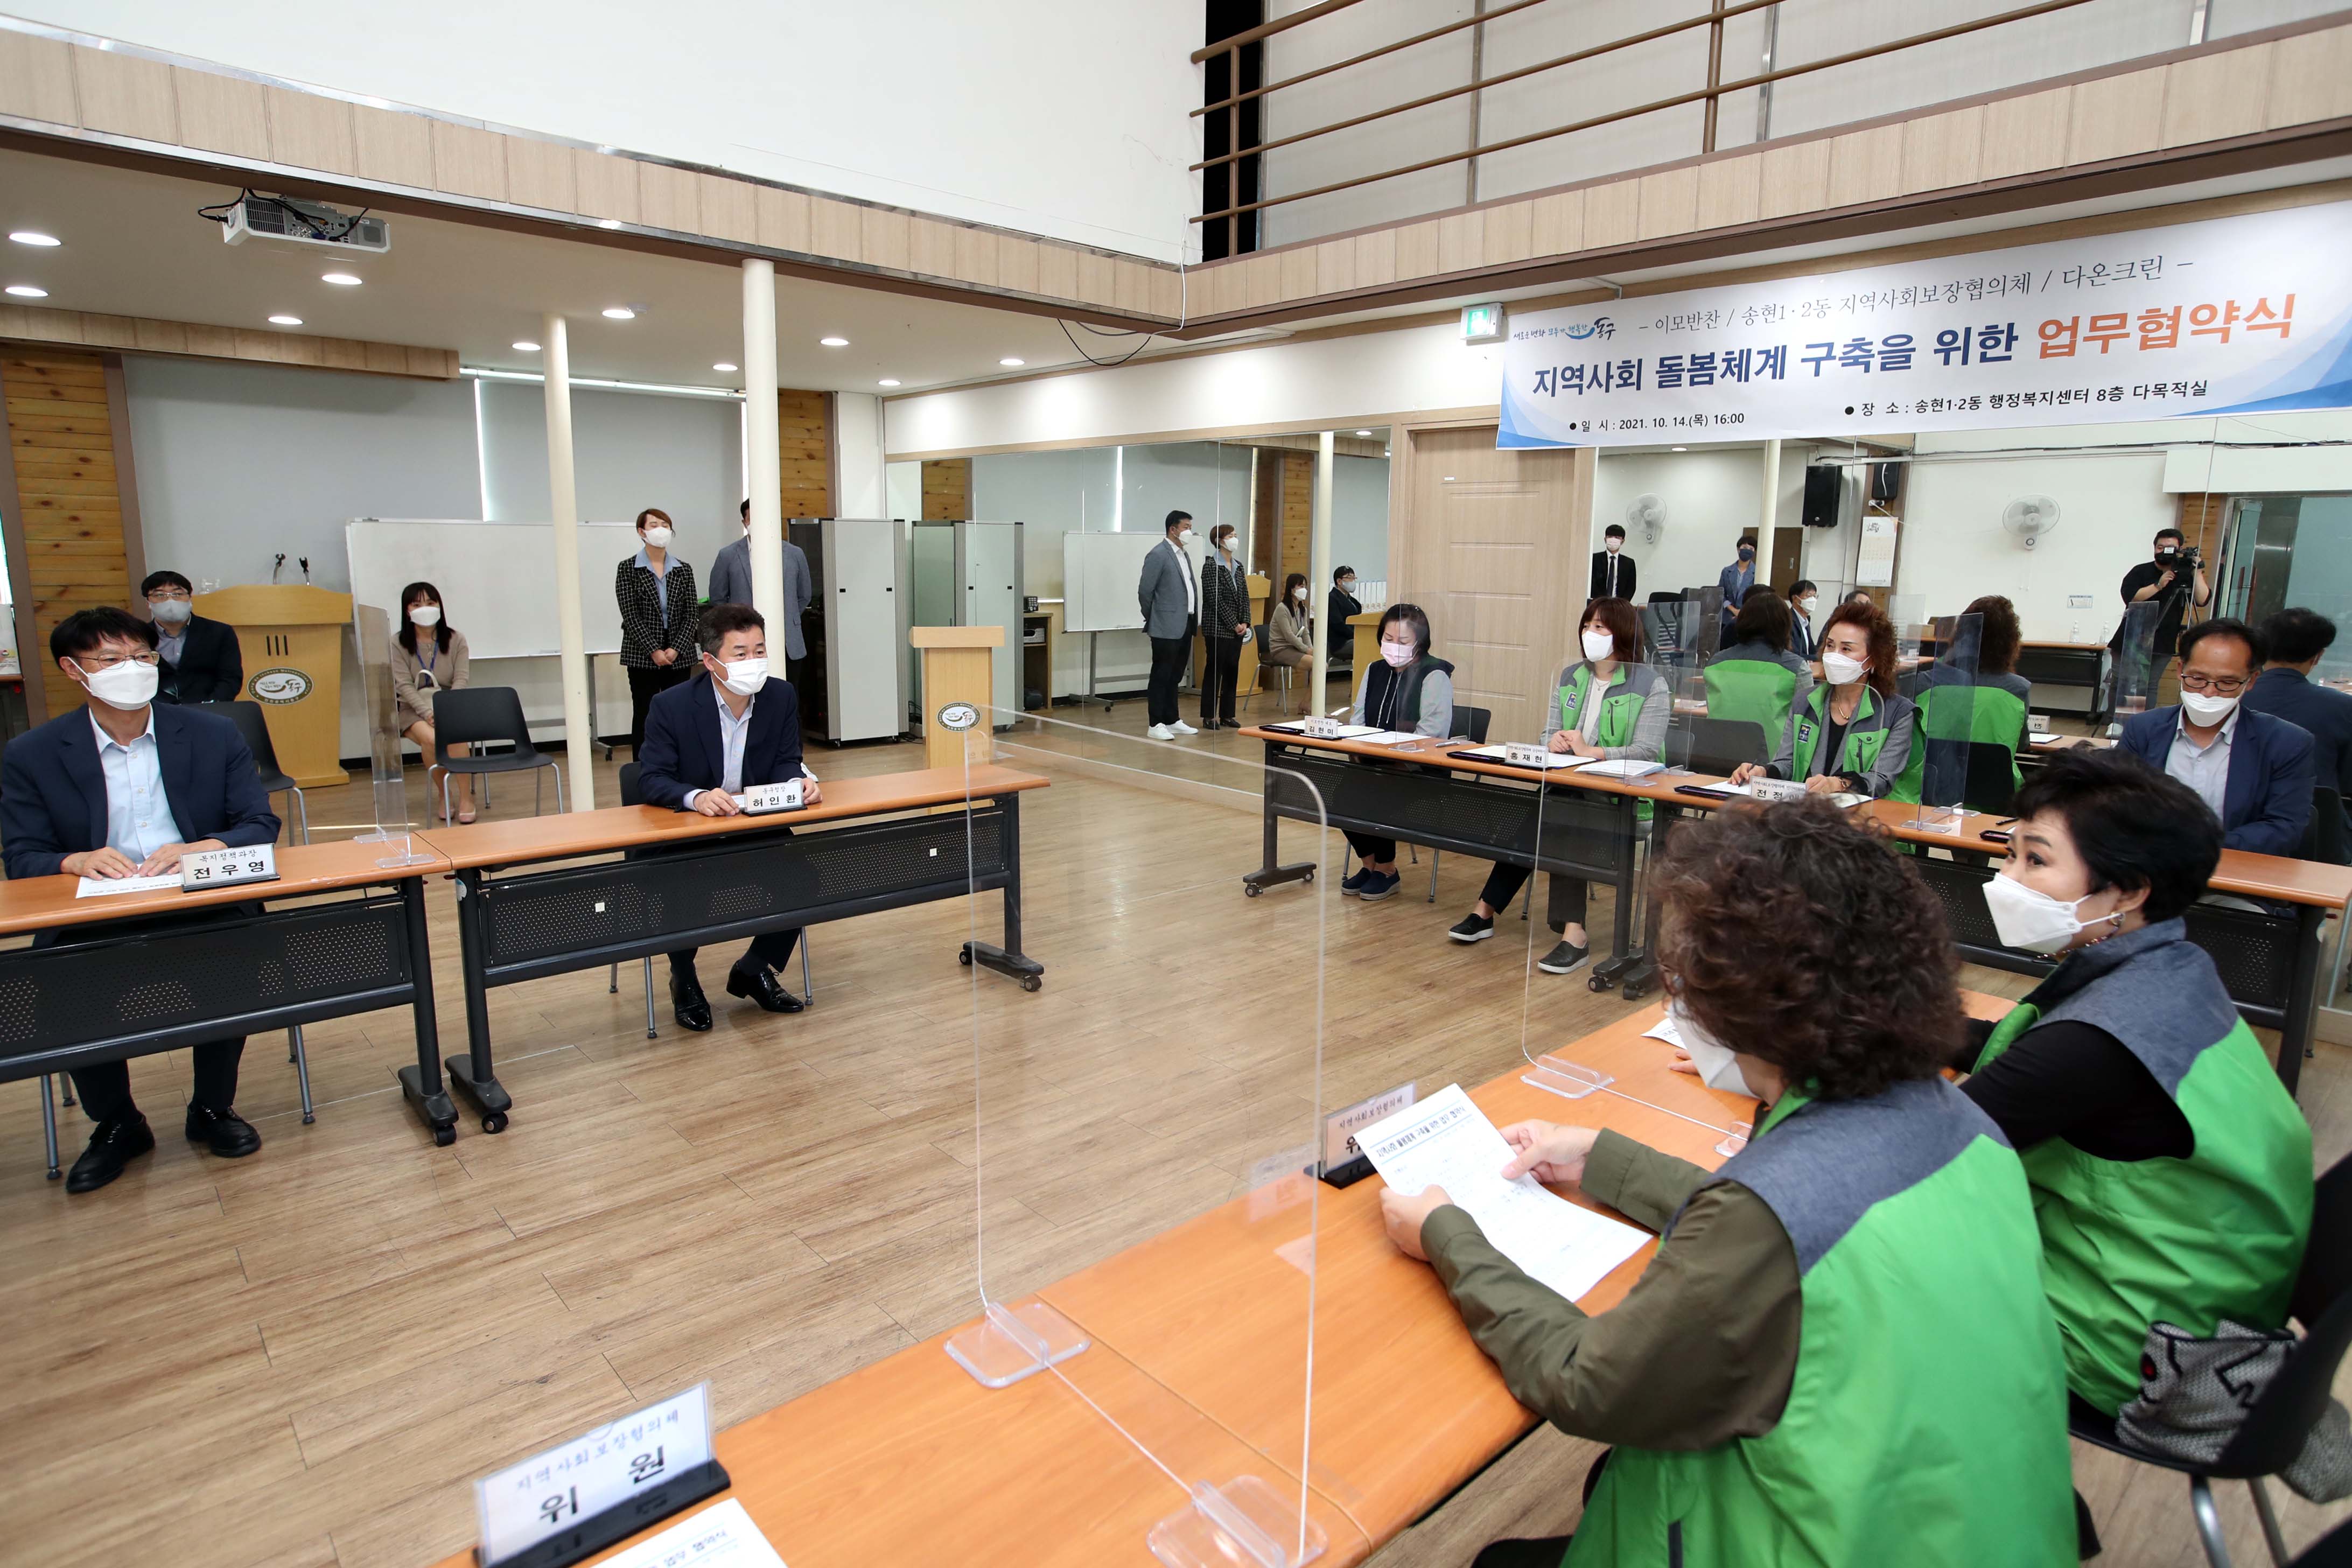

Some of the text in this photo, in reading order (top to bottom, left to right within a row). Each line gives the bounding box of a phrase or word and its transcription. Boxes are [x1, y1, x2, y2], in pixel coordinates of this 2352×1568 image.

[1655, 309, 1720, 334] 이모반찬
[1839, 271, 2031, 314] 지역사회보장협의체
[2063, 255, 2163, 290] 다온크린
[1514, 332, 1530, 340] 새로운
[1531, 329, 1546, 338] 변화
[1548, 327, 1565, 337] 모두가
[1594, 317, 1616, 340] 동구
[1532, 293, 2296, 397] 지역사회 돌봄체계 구축을 위한 업무협약식
[1989, 388, 2089, 409] 행정복지센터
[2097, 385, 2124, 403] 8층
[2133, 379, 2208, 400] 다목적실
[1619, 418, 1647, 430] 2021.
[1653, 418, 1667, 428] 10.
[1714, 413, 1745, 425] 16:00
[199, 849, 257, 863] 복지정책과장
